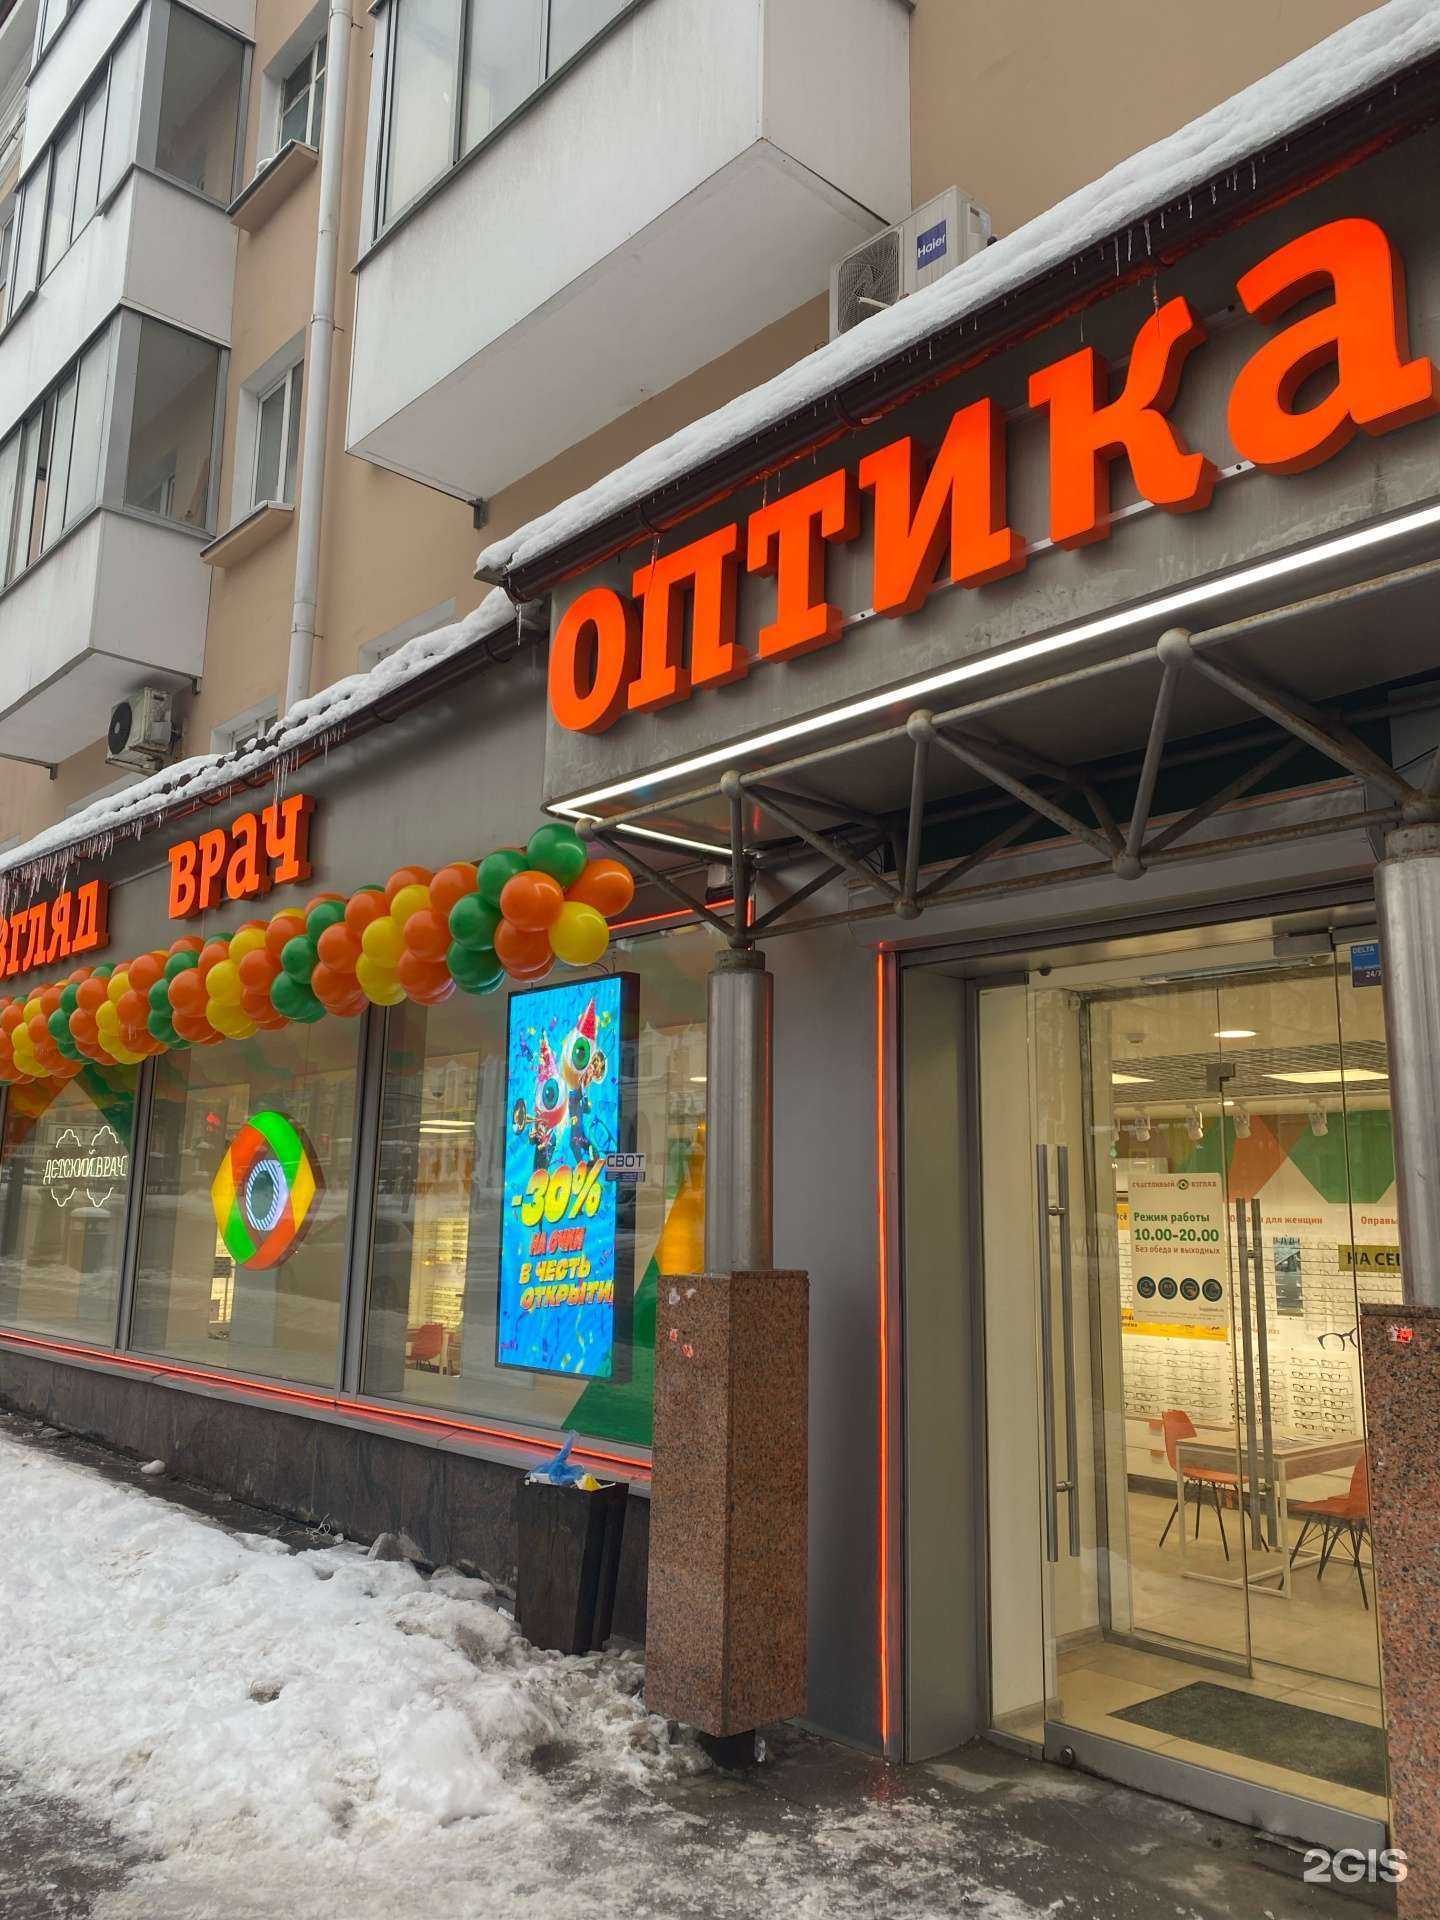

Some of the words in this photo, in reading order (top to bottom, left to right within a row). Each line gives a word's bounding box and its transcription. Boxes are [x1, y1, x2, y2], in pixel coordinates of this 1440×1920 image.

[917, 234, 946, 258] Haier
[548, 217, 1438, 734] оптика
[43, 1149, 97, 1185] ДЕТСКИЙ
[96, 1155, 128, 1178] ВРАЧ
[511, 1159, 606, 1227] -30%
[1133, 1212, 1168, 1222] Режим
[1171, 1212, 1210, 1223] работы
[1265, 1217, 1283, 1225] для
[1284, 1217, 1323, 1226] женщин
[530, 1231, 547, 1257] НА
[1134, 1228, 1219, 1242] 10.00-20.00
[1135, 1245, 1149, 1254] Без
[1150, 1245, 1172, 1255] обеда
[1180, 1246, 1221, 1256] выходных
[1347, 1251, 1371, 1265] НА
[519, 1262, 533, 1284] В
[535, 1254, 592, 1283] ЧЕСТЬ
[520, 1279, 614, 1311] ОТКРЫТИ
